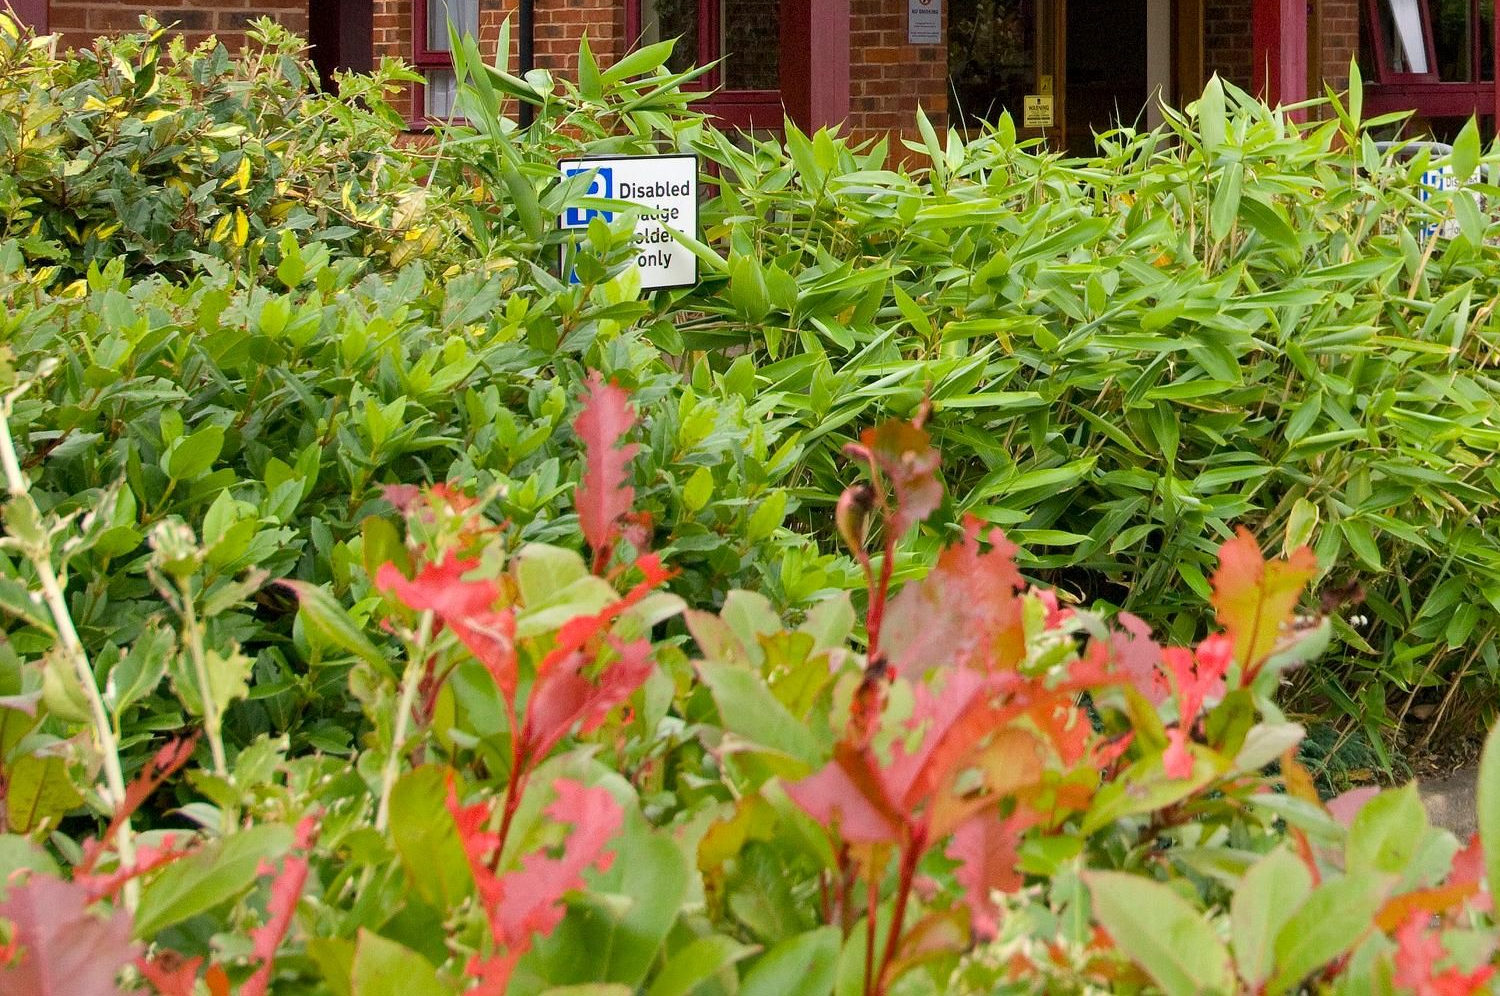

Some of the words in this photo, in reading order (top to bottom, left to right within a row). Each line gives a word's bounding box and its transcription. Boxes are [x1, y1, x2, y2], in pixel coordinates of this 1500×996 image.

[619, 180, 690, 199] Disabled
[637, 204, 679, 223] adge
[637, 249, 672, 269] only
